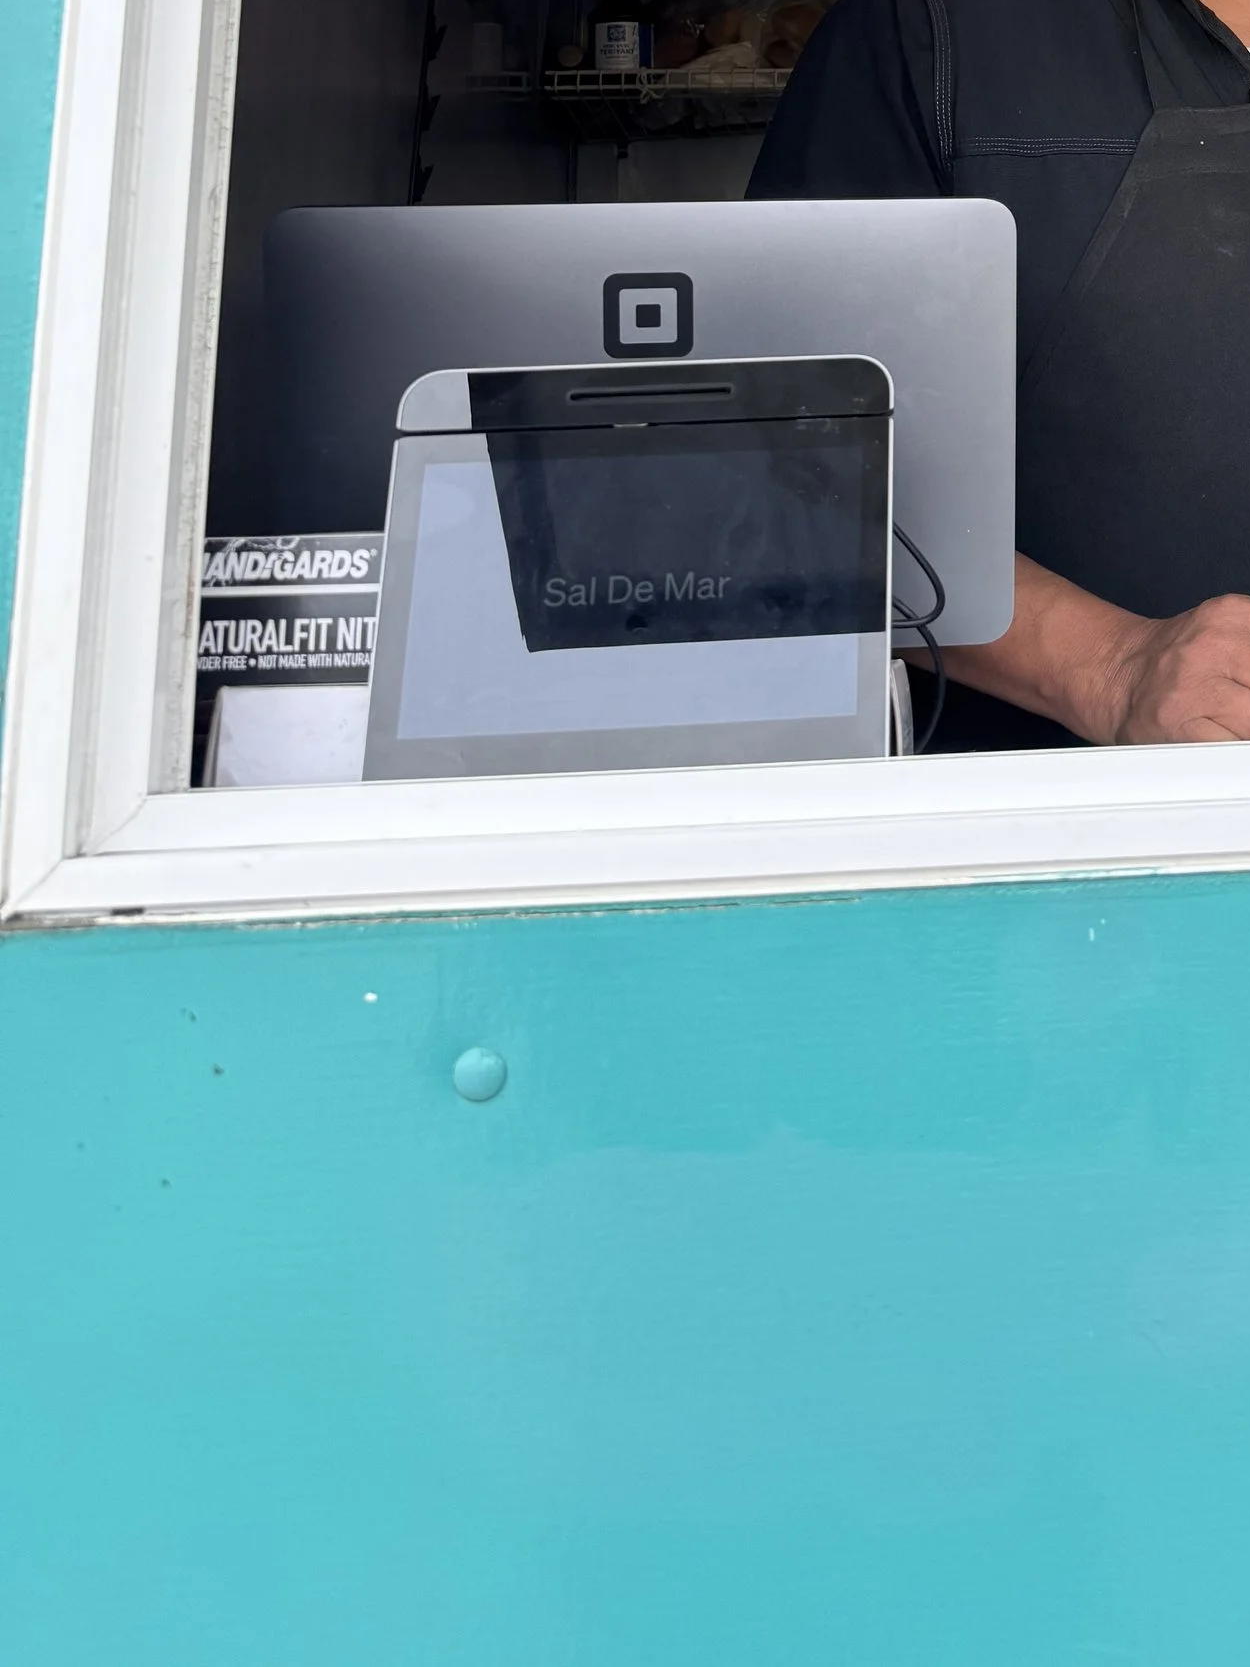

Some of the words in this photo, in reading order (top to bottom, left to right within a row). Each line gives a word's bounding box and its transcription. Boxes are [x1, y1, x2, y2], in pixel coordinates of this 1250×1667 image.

[543, 576, 597, 607] Sal
[607, 574, 654, 605] De
[664, 571, 732, 601] Mar
[222, 655, 247, 670] FREE
[258, 654, 277, 669] NOT
[279, 653, 306, 668] MADE
[307, 653, 333, 667] WITH
